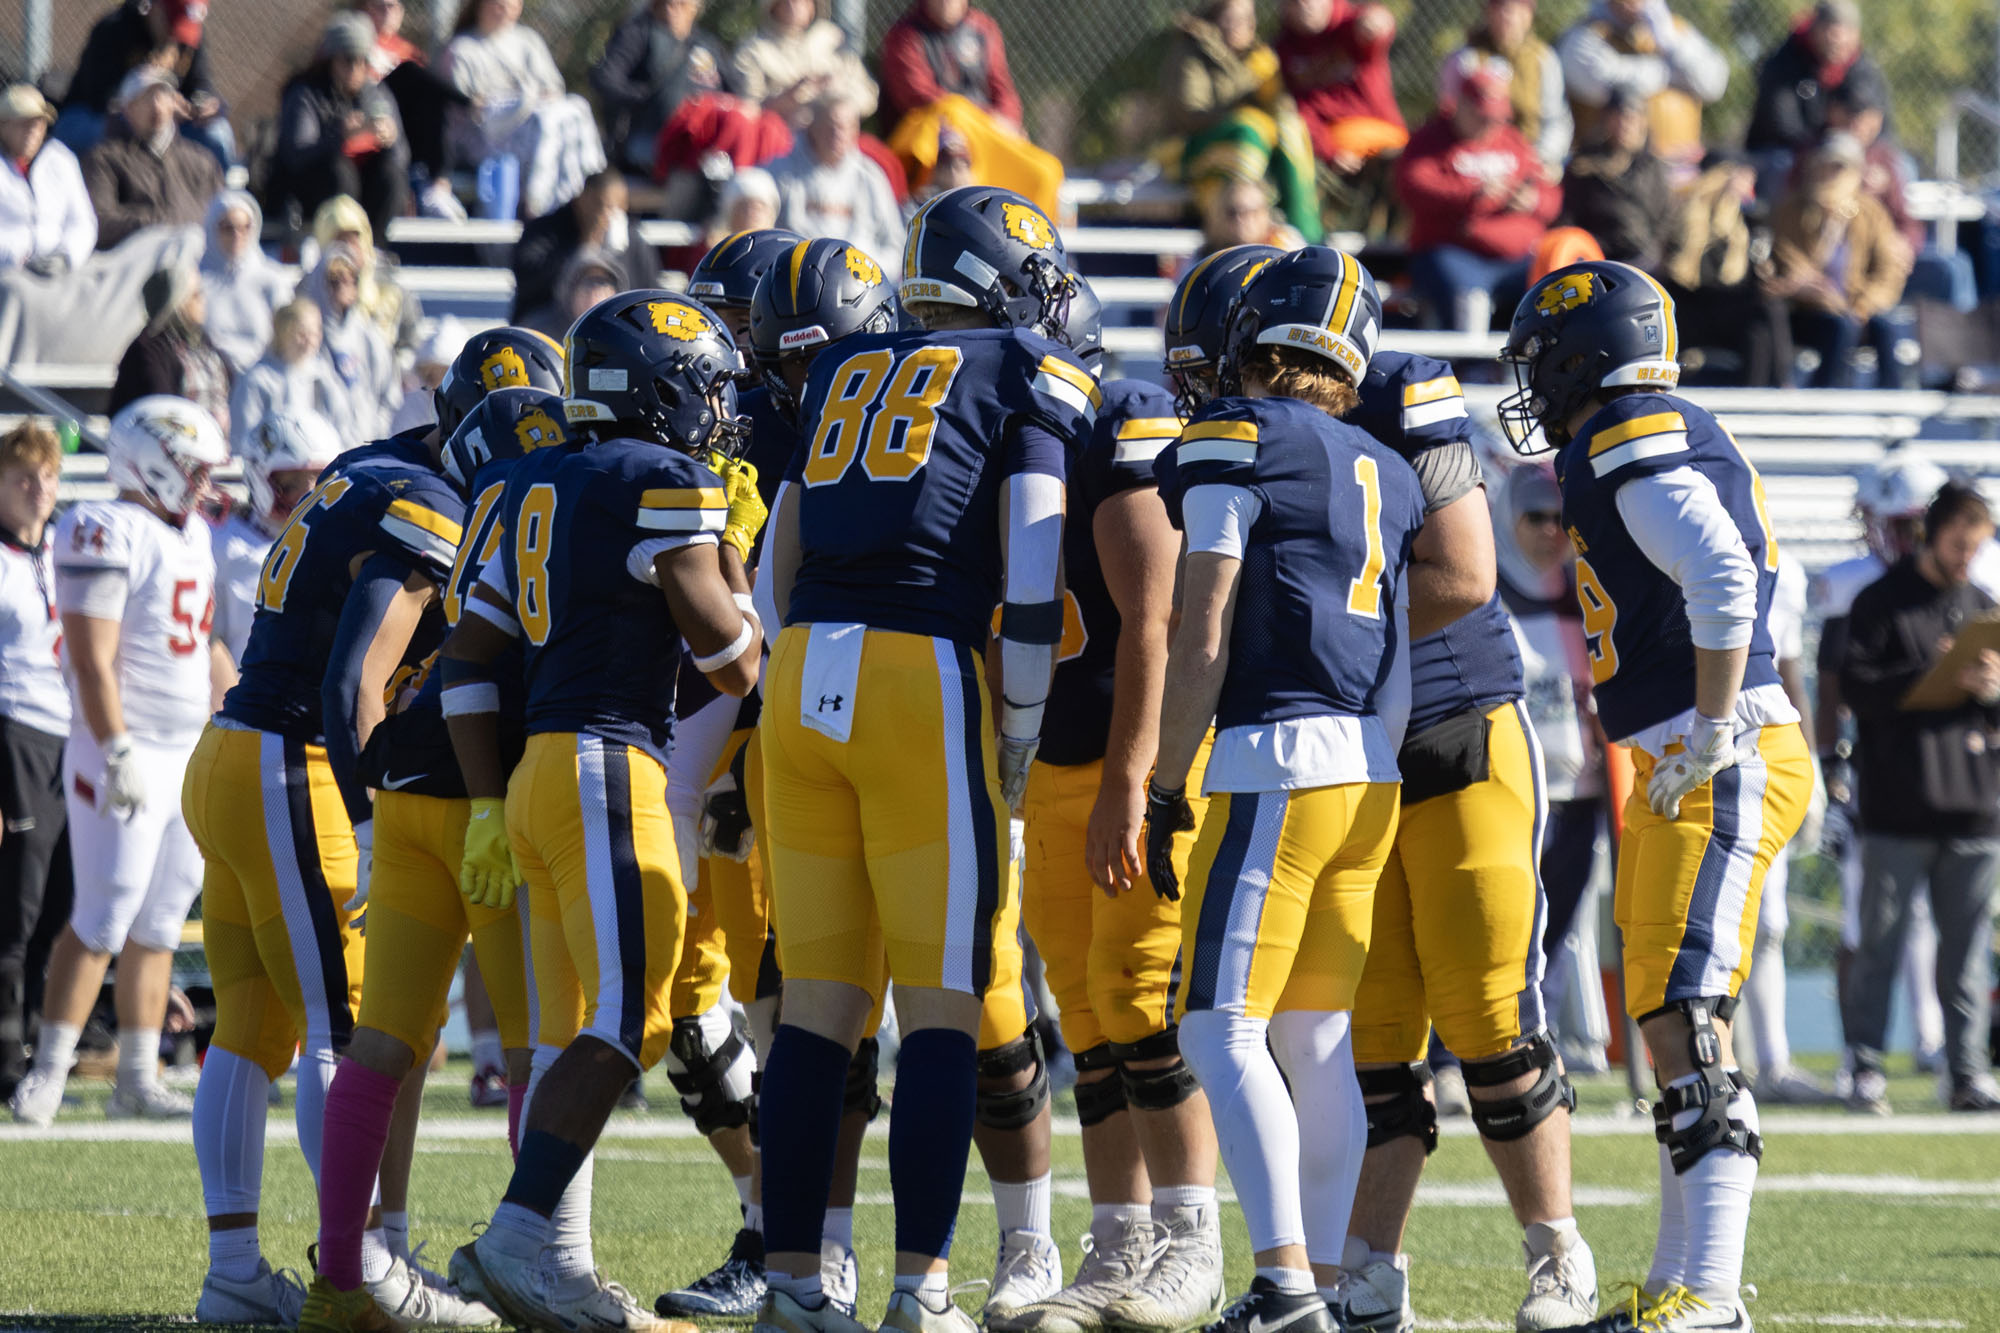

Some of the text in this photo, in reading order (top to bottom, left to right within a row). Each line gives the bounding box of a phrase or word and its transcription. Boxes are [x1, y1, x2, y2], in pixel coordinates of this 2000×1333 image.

[783, 327, 820, 345] Riddell
[1287, 327, 1362, 373] BEAVERS
[803, 347, 963, 488] 88
[516, 484, 557, 646] 8
[1347, 454, 1386, 620] 1
